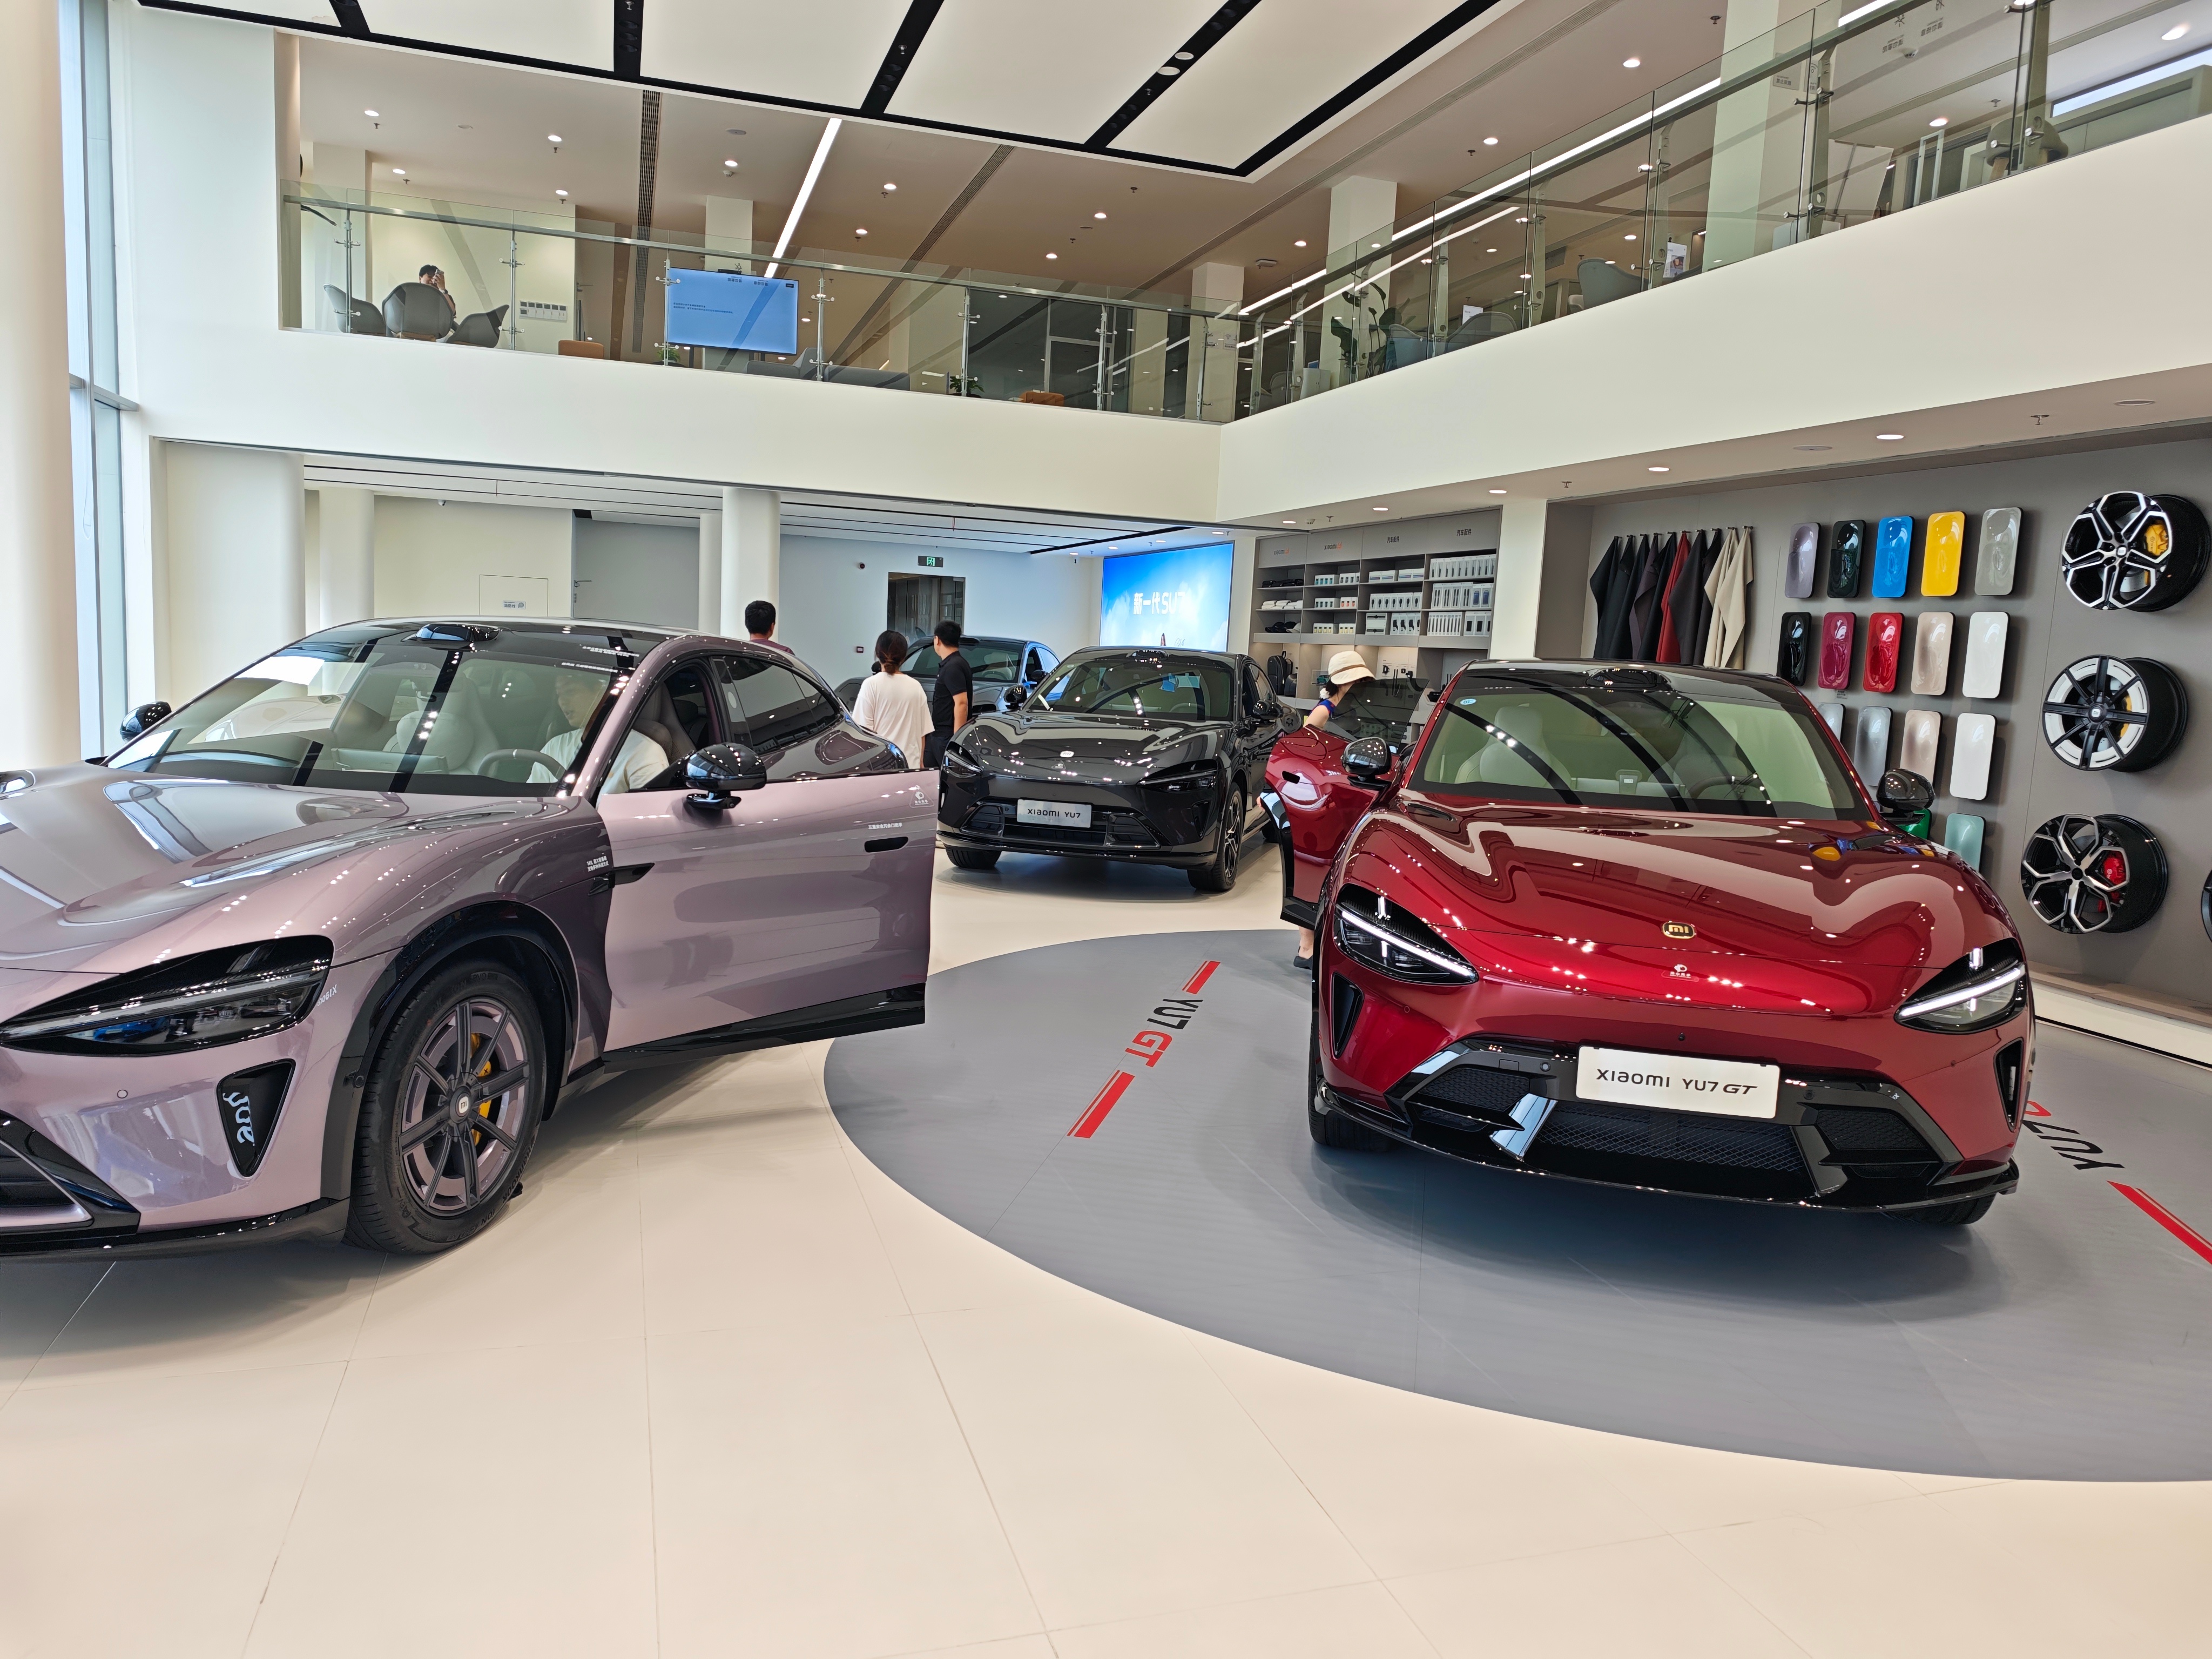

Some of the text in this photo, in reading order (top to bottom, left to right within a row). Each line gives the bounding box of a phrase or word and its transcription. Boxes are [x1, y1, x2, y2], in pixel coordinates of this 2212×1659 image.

[1456, 529, 1472, 537] 汽车配件
[1125, 999, 1204, 1068] YU7 GT
[1682, 1078, 1719, 1092] YU7
[1723, 1084, 1758, 1095] GT
[2021, 1120, 2126, 1170] YU7
